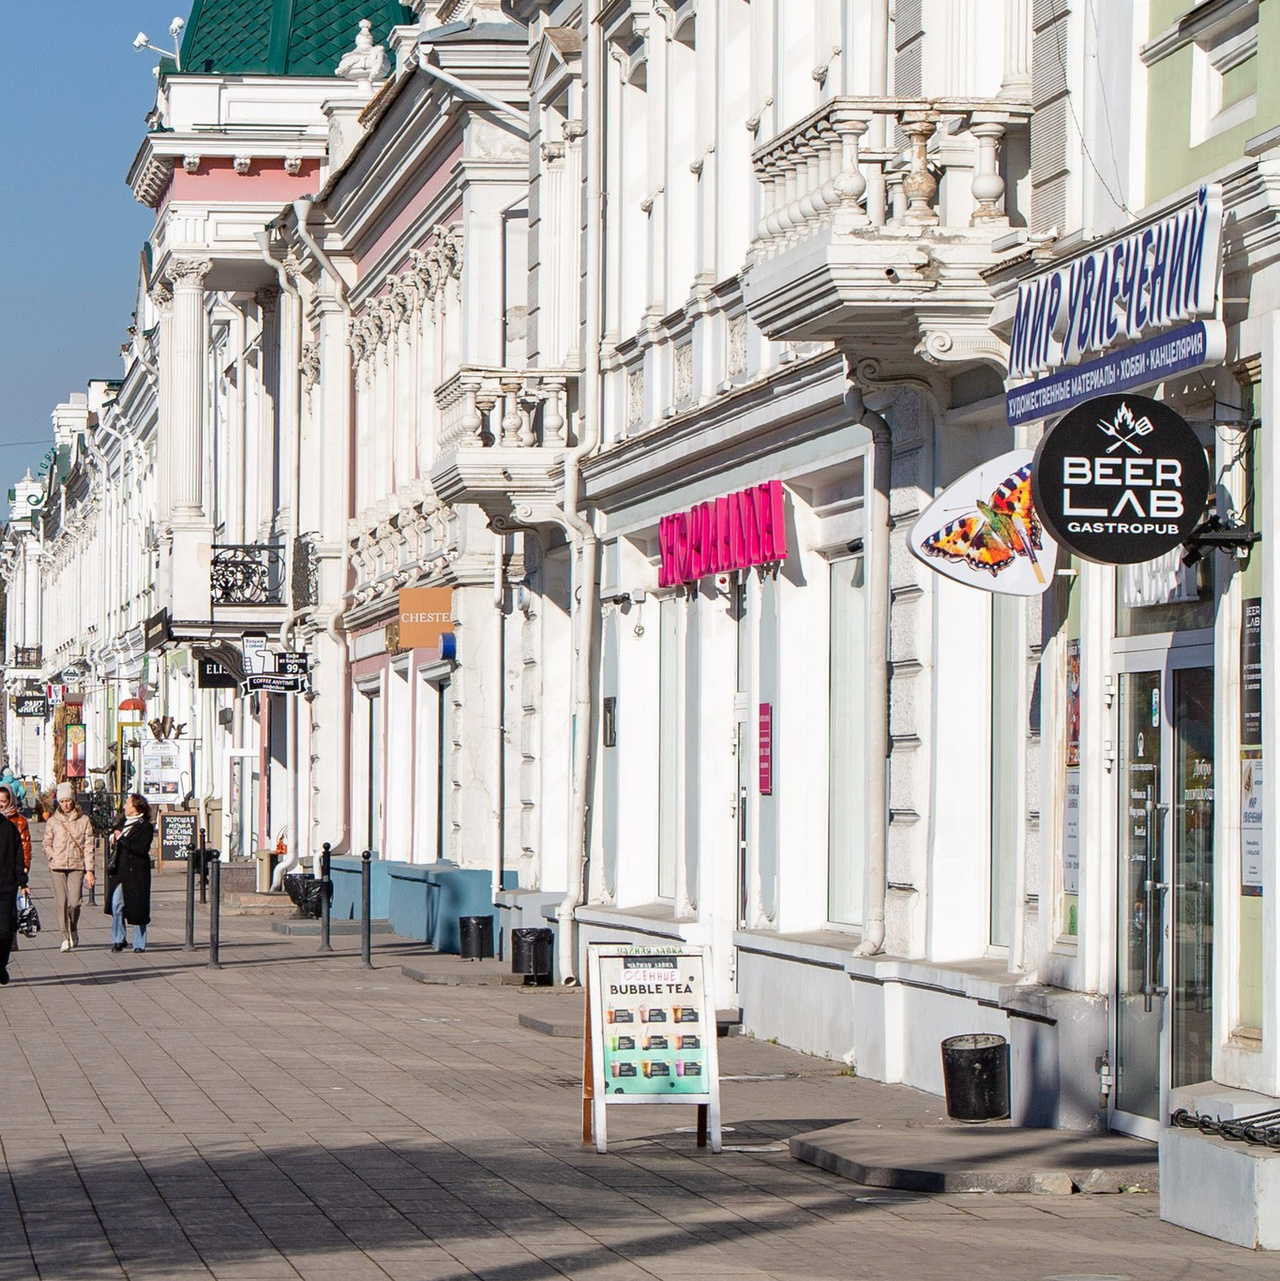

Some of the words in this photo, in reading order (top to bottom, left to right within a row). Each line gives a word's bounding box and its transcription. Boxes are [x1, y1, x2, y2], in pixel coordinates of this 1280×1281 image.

[1009, 272, 1062, 376] МИР
[1063, 185, 1208, 364] УВЛЕЧЕНИЙ
[1007, 381, 1071, 419] ХУДОЖЕСТВЕННЫЕ
[1071, 363, 1117, 397] МАТЕРИАЛЫ
[1120, 352, 1146, 380] ХОББИ
[1150, 331, 1204, 369] КАНЦЕЛЯРИЯ
[1063, 456, 1183, 487] BEER
[1062, 487, 1185, 519] LAB
[1067, 521, 1180, 535] GASTROPUB
[286, 663, 299, 673] 99
[623, 970, 677, 982] ОСЕННИЕ
[610, 984, 663, 995] BUBBLE
[667, 984, 693, 994] TEA
